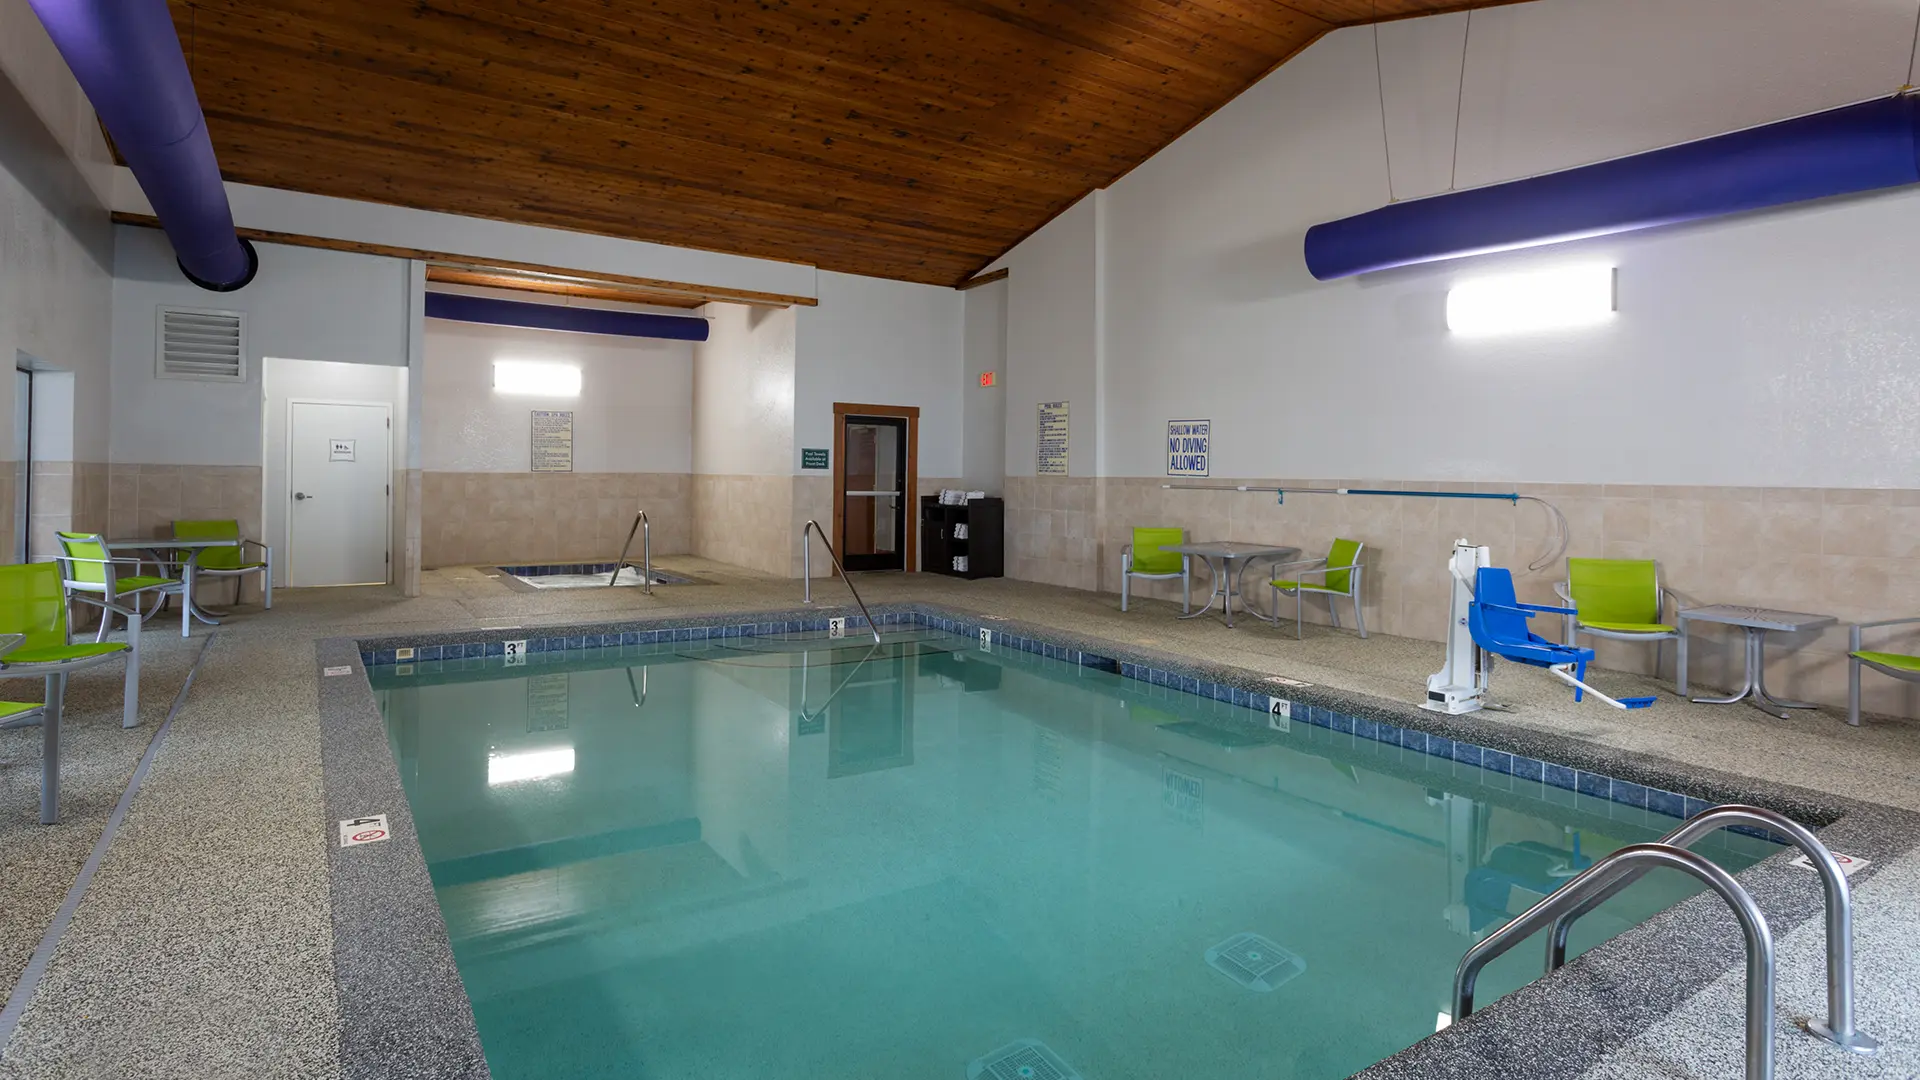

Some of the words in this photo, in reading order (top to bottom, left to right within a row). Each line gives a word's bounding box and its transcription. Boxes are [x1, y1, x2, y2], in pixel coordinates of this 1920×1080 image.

[1170, 425, 1191, 435] SHALLOW
[1192, 424, 1208, 435] WATER
[1170, 438, 1180, 453] NO
[1182, 438, 1207, 453] DIVING
[1170, 455, 1206, 471] ALLOWED
[831, 620, 838, 630] 3
[981, 630, 986, 641] 3
[507, 643, 517, 655] 3
[1272, 701, 1281, 715] 4
